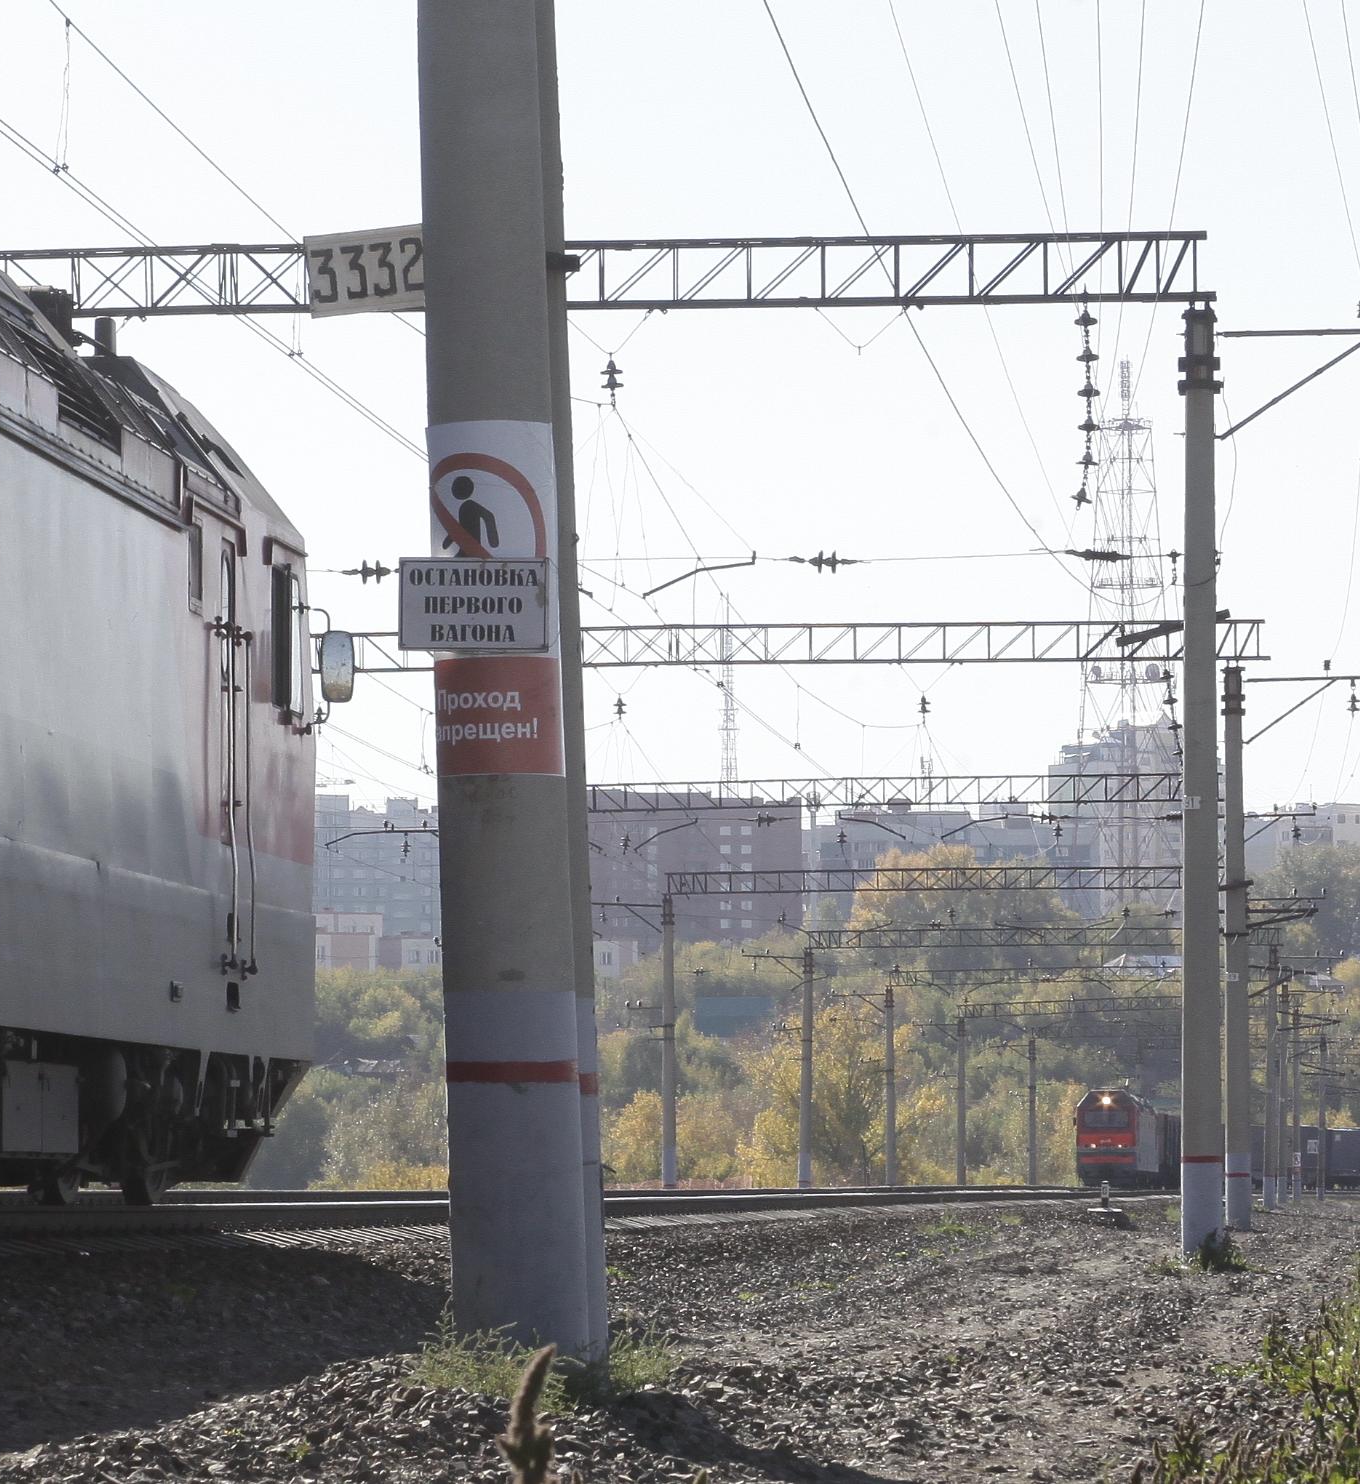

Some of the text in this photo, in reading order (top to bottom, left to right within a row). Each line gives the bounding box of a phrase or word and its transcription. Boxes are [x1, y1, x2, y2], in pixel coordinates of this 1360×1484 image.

[310, 237, 424, 303] 3332
[409, 567, 539, 587] ОСТАНОВКА
[424, 595, 523, 615] ПЕРВОГО
[430, 623, 516, 643] ВАГОНА
[438, 690, 521, 715] Проход
[436, 717, 538, 746] апрещен!
